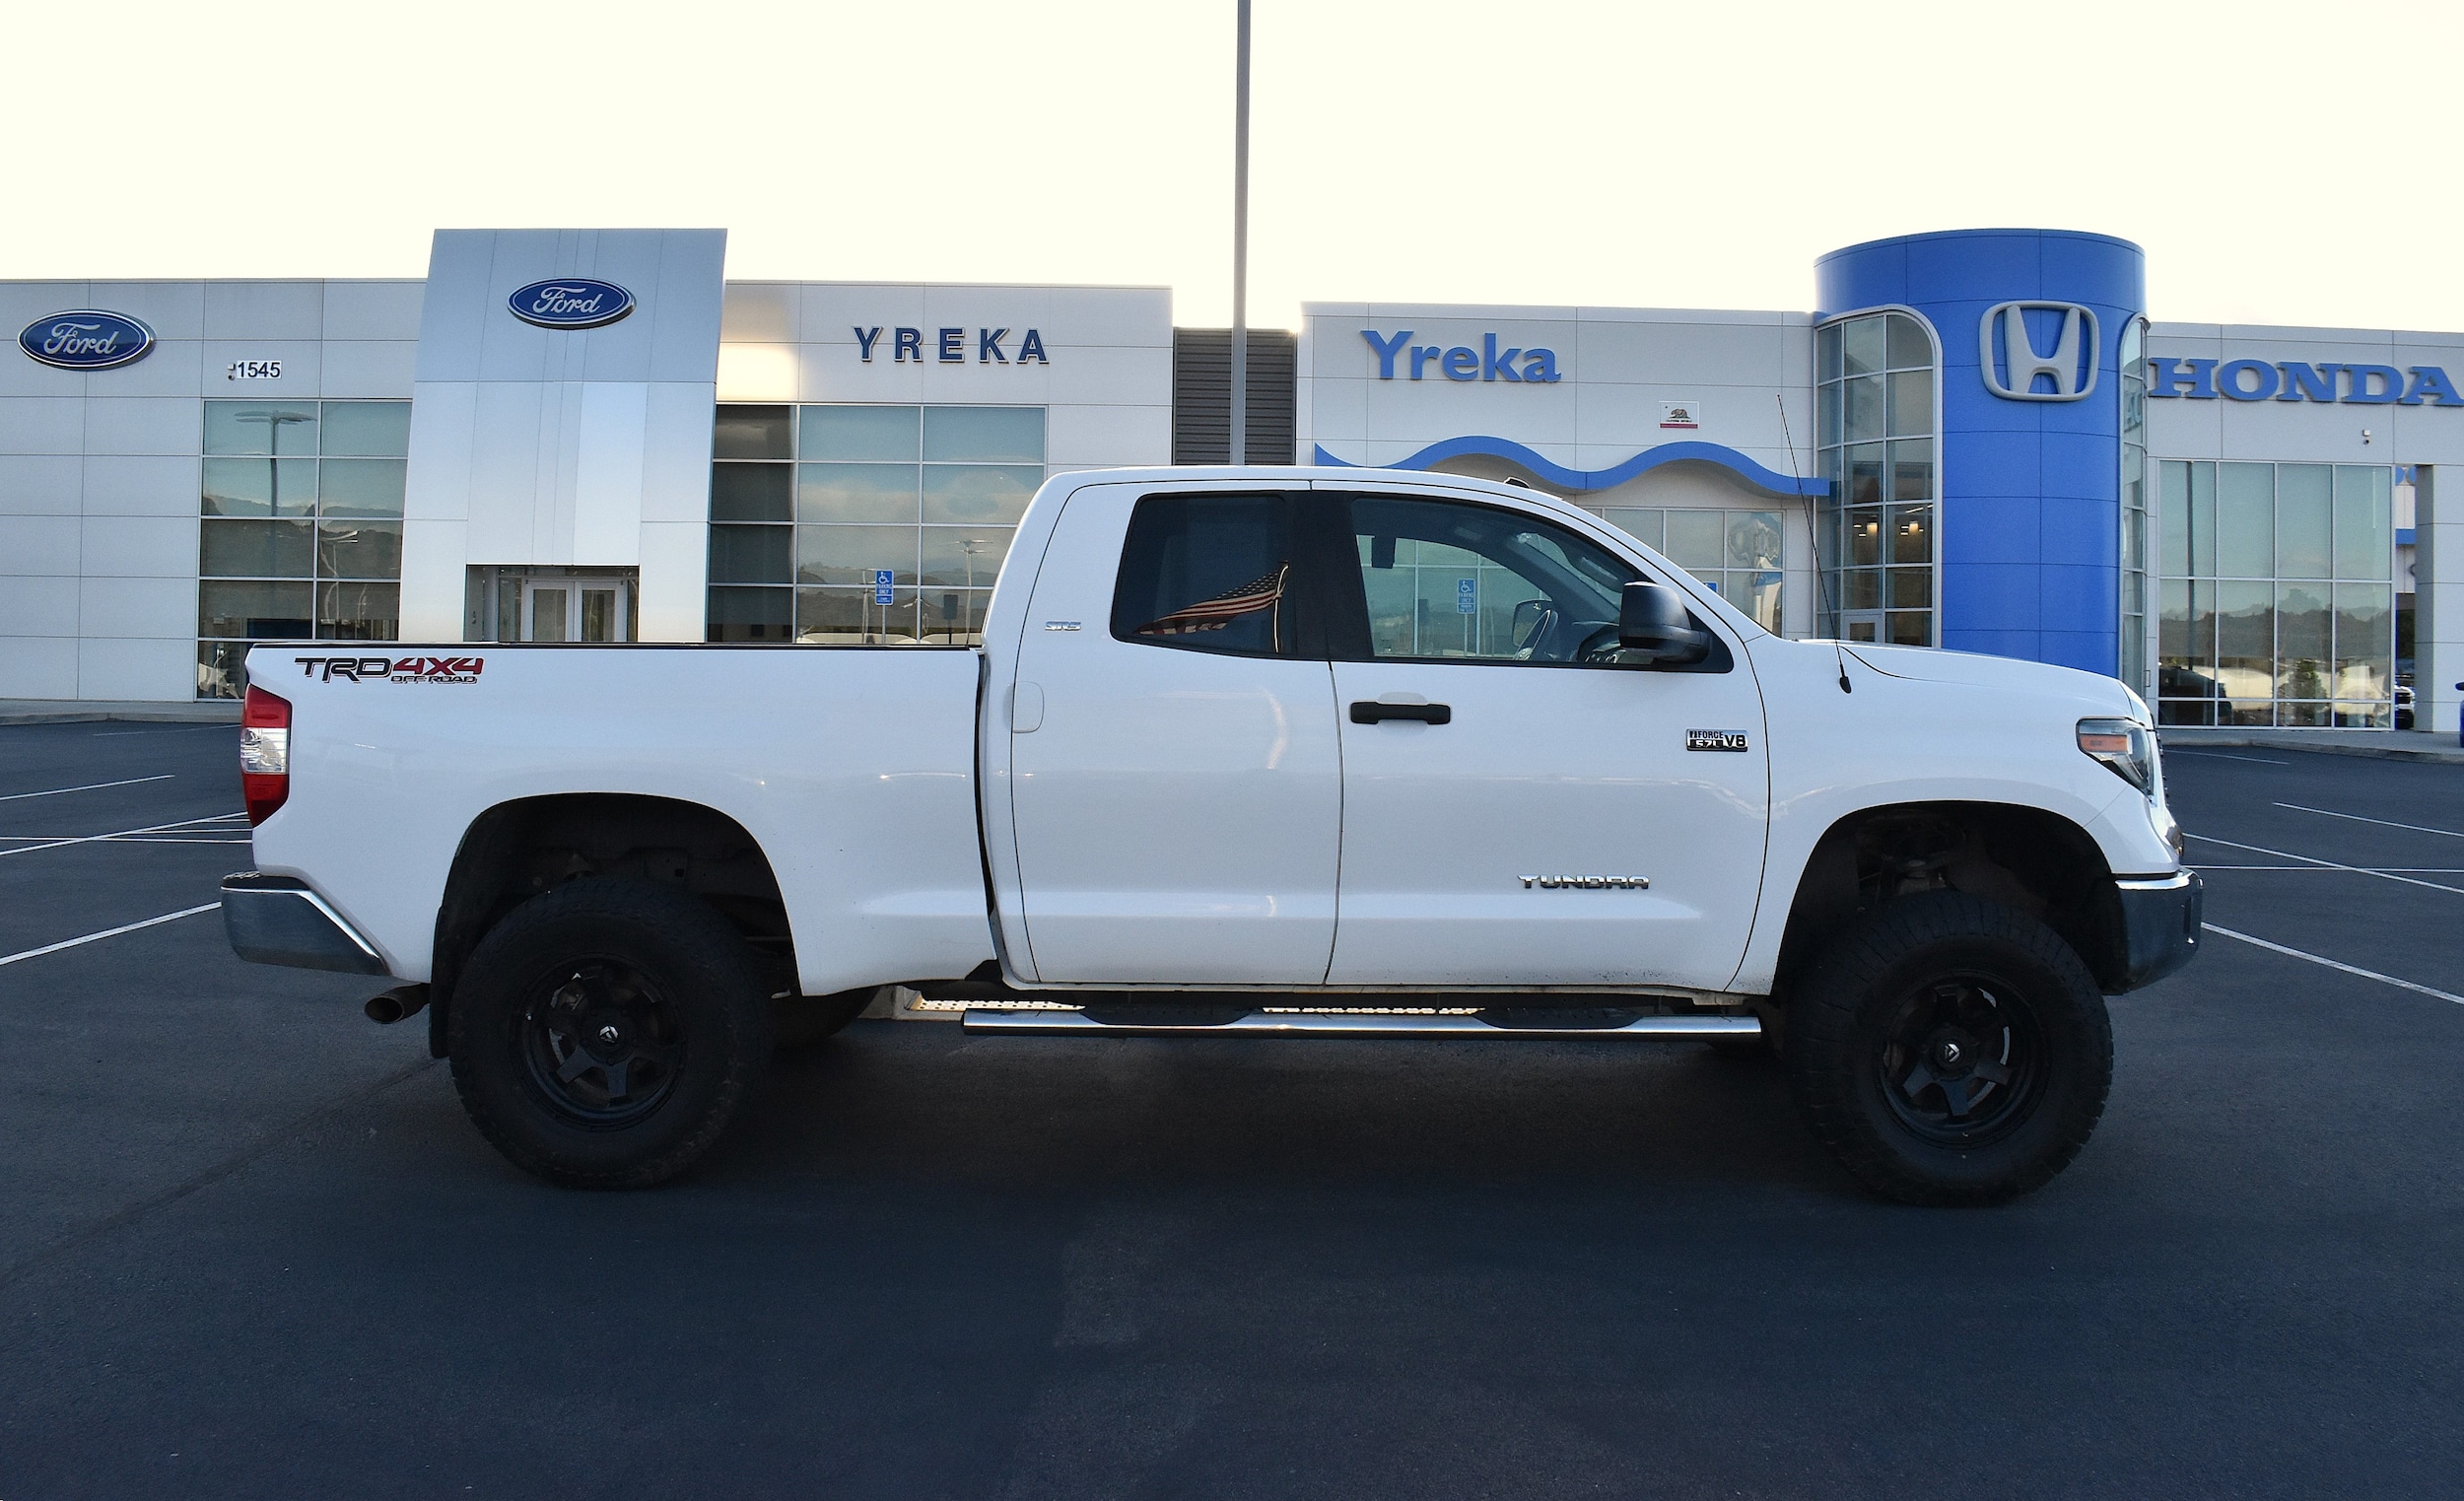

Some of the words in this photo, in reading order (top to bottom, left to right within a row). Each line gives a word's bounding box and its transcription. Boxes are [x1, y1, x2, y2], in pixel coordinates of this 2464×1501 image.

[532, 286, 603, 313] Ford
[43, 322, 119, 355] Ford
[852, 325, 1050, 364] YREKA
[1359, 329, 1562, 382] Yreka
[238, 362, 281, 378] 1545
[2147, 356, 2464, 406] HONDA
[390, 675, 427, 685] OFF
[428, 675, 479, 685] ROAD
[1724, 734, 1746, 747] V8
[1518, 874, 1650, 890] TUNDRA
